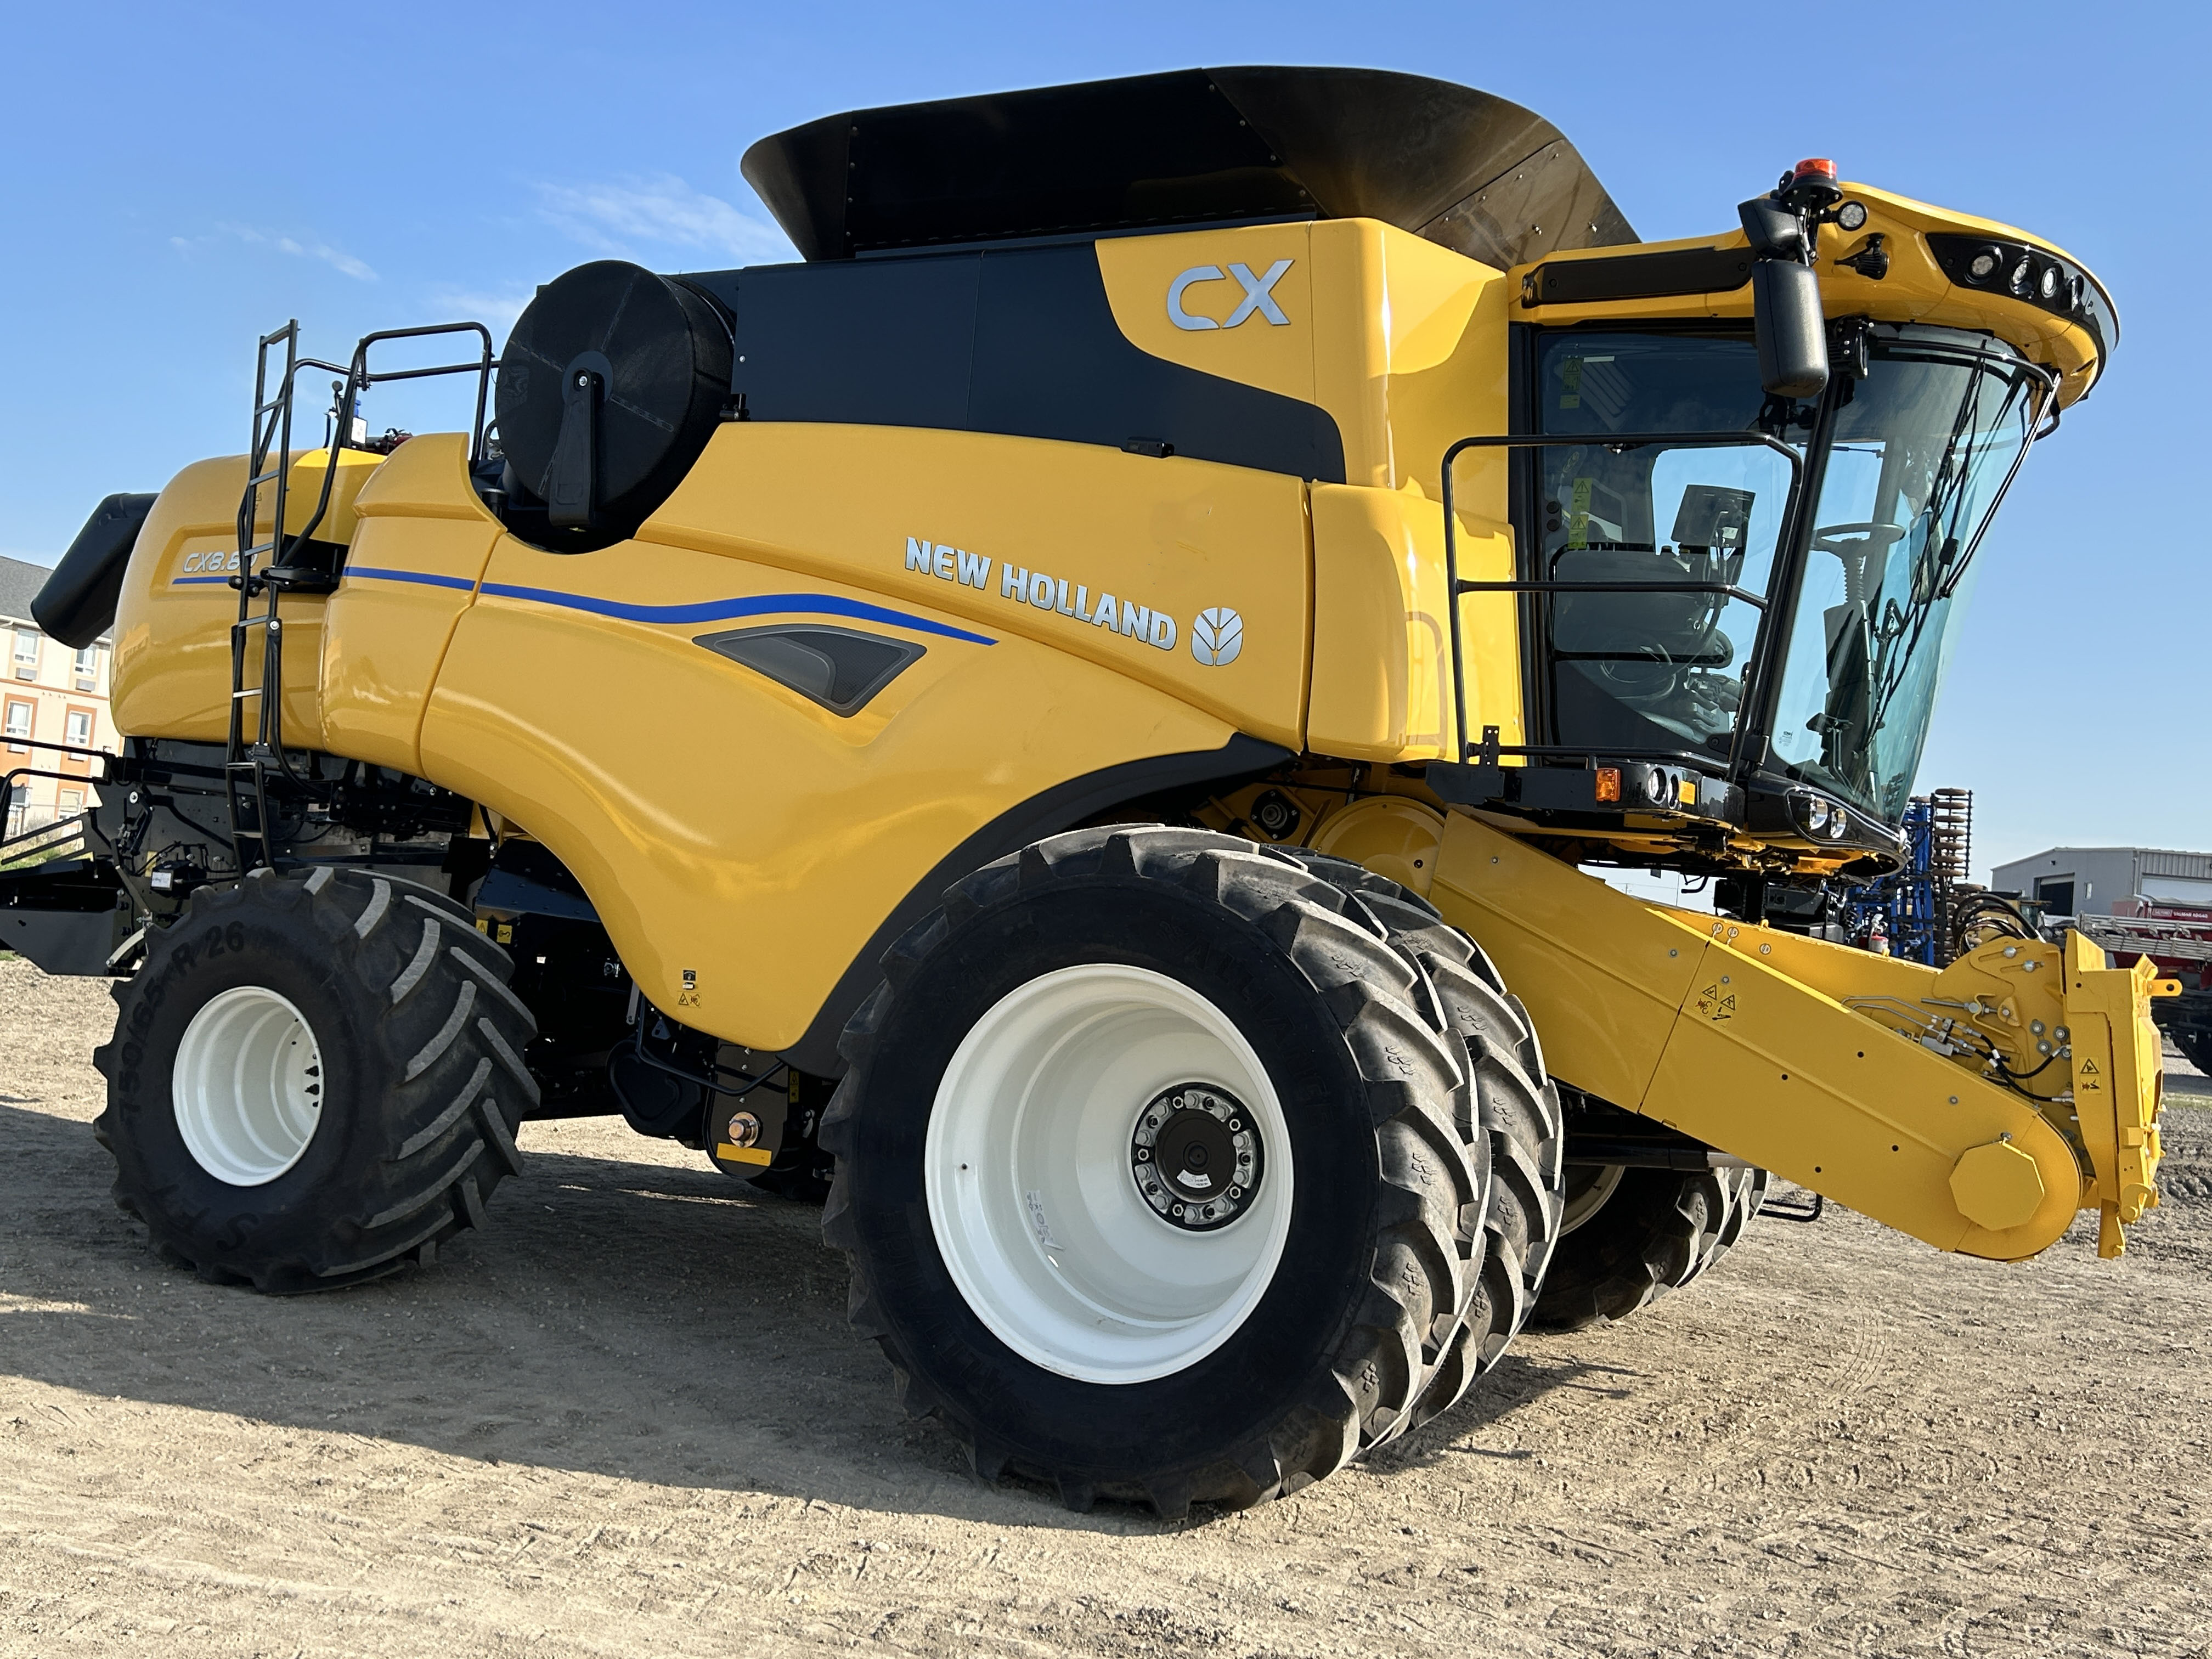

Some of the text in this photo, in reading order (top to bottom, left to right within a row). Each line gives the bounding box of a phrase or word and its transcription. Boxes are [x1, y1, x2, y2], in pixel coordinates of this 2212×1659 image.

[1167, 259, 1295, 331] CX
[905, 537, 1177, 651] NEW HOLLAND
[205, 921, 245, 958] 26
